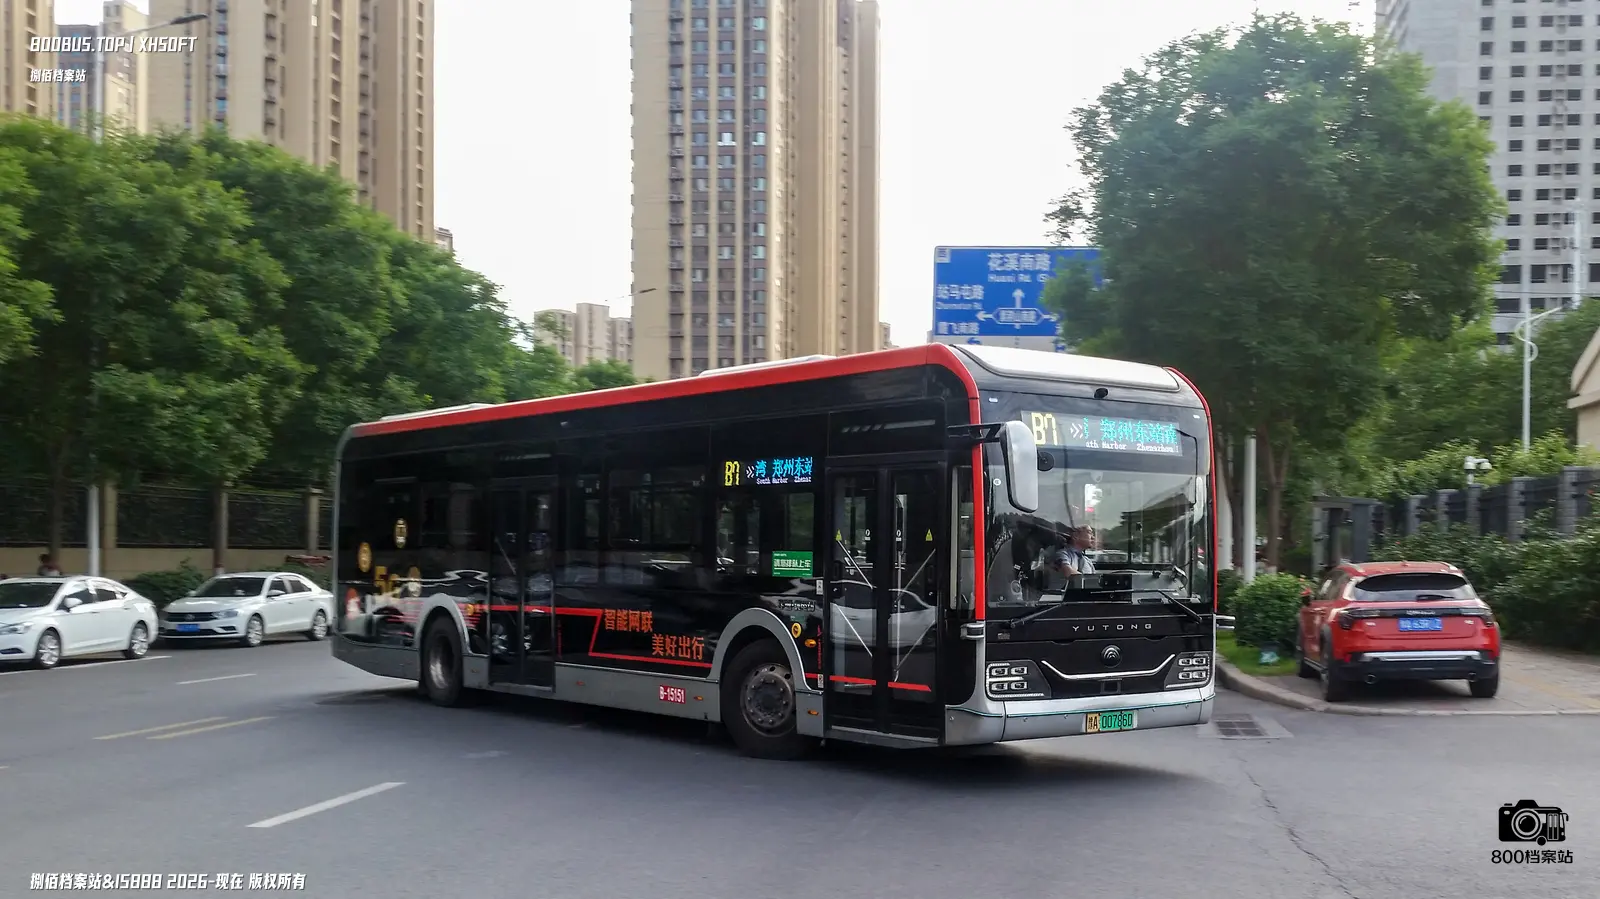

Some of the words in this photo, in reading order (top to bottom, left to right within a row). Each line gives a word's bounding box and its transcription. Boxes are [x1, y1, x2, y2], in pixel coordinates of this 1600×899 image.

[988, 252, 1052, 271] 花溪南路
[938, 321, 980, 335] 飞南路
[1031, 412, 1058, 446] B7
[1102, 440, 1128, 450] Harbor
[725, 460, 741, 486] B7
[755, 459, 767, 477] 湾
[756, 476, 771, 485] South
[772, 476, 789, 484] Harbor
[604, 608, 653, 633] 智能网联
[1072, 623, 1153, 632] YUTONG
[652, 633, 705, 660] 美好出行
[659, 685, 685, 703] B-15151
